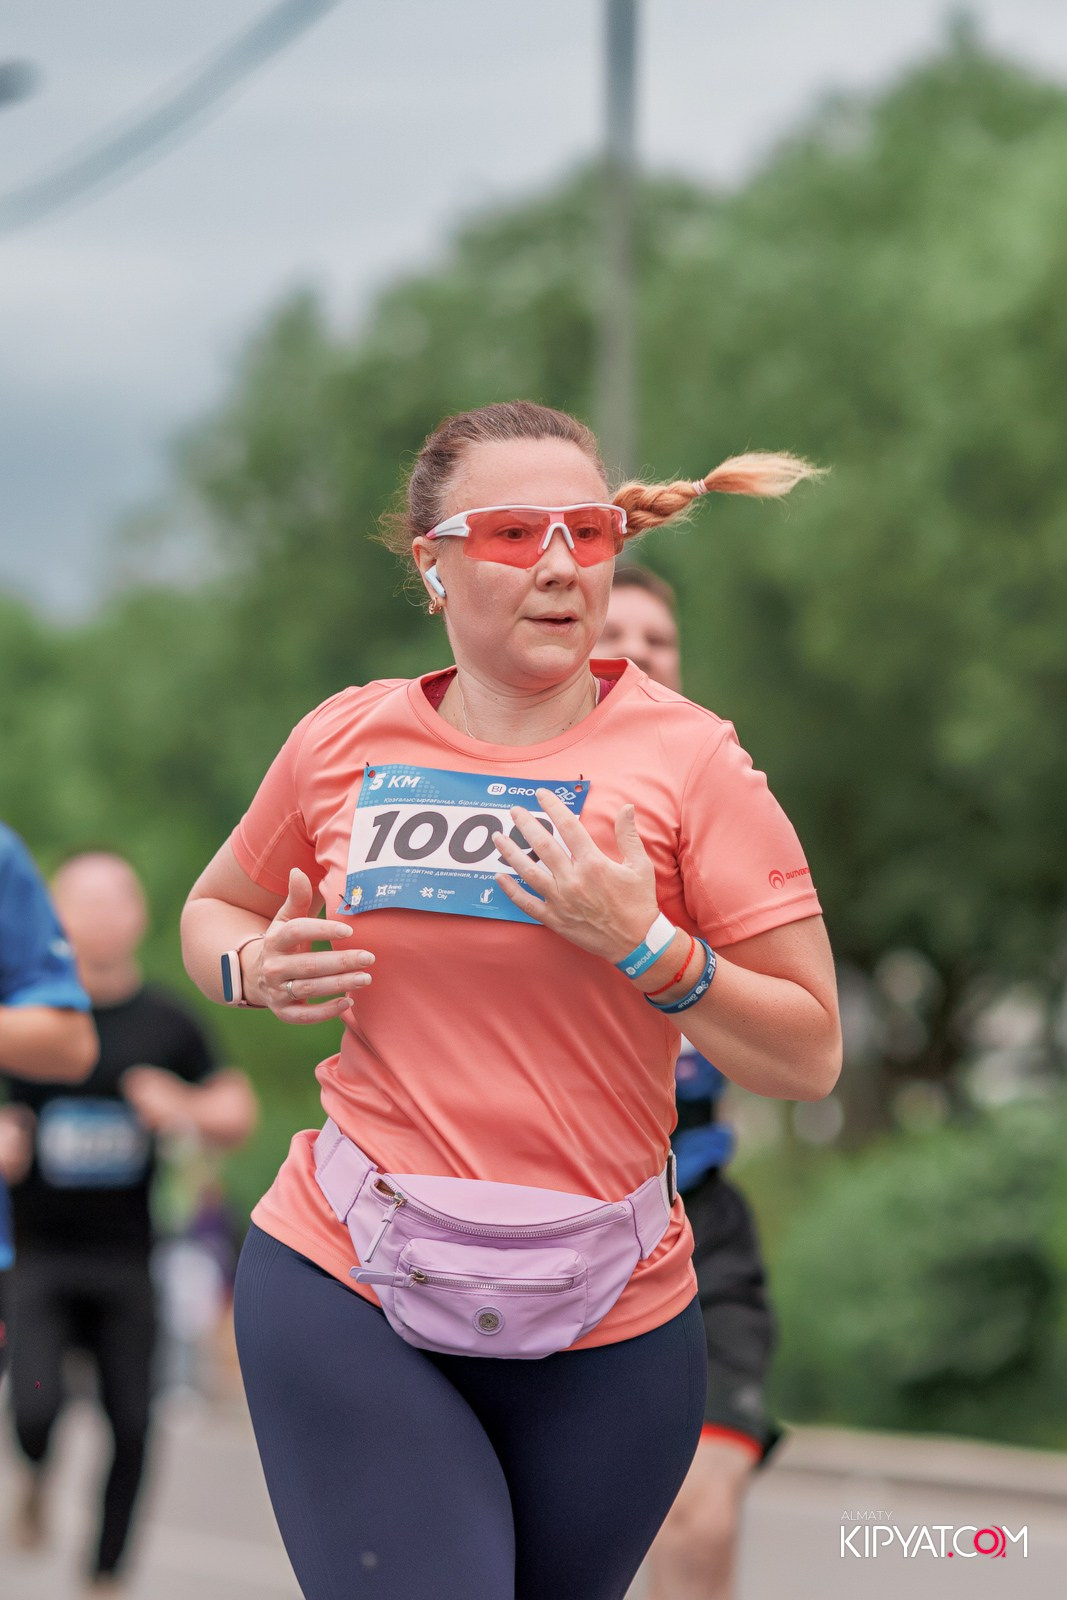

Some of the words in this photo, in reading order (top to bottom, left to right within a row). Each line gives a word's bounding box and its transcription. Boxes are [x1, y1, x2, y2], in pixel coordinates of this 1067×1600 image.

[369, 773, 386, 791] 5
[388, 775, 421, 789] KM
[508, 787, 536, 796] GRO
